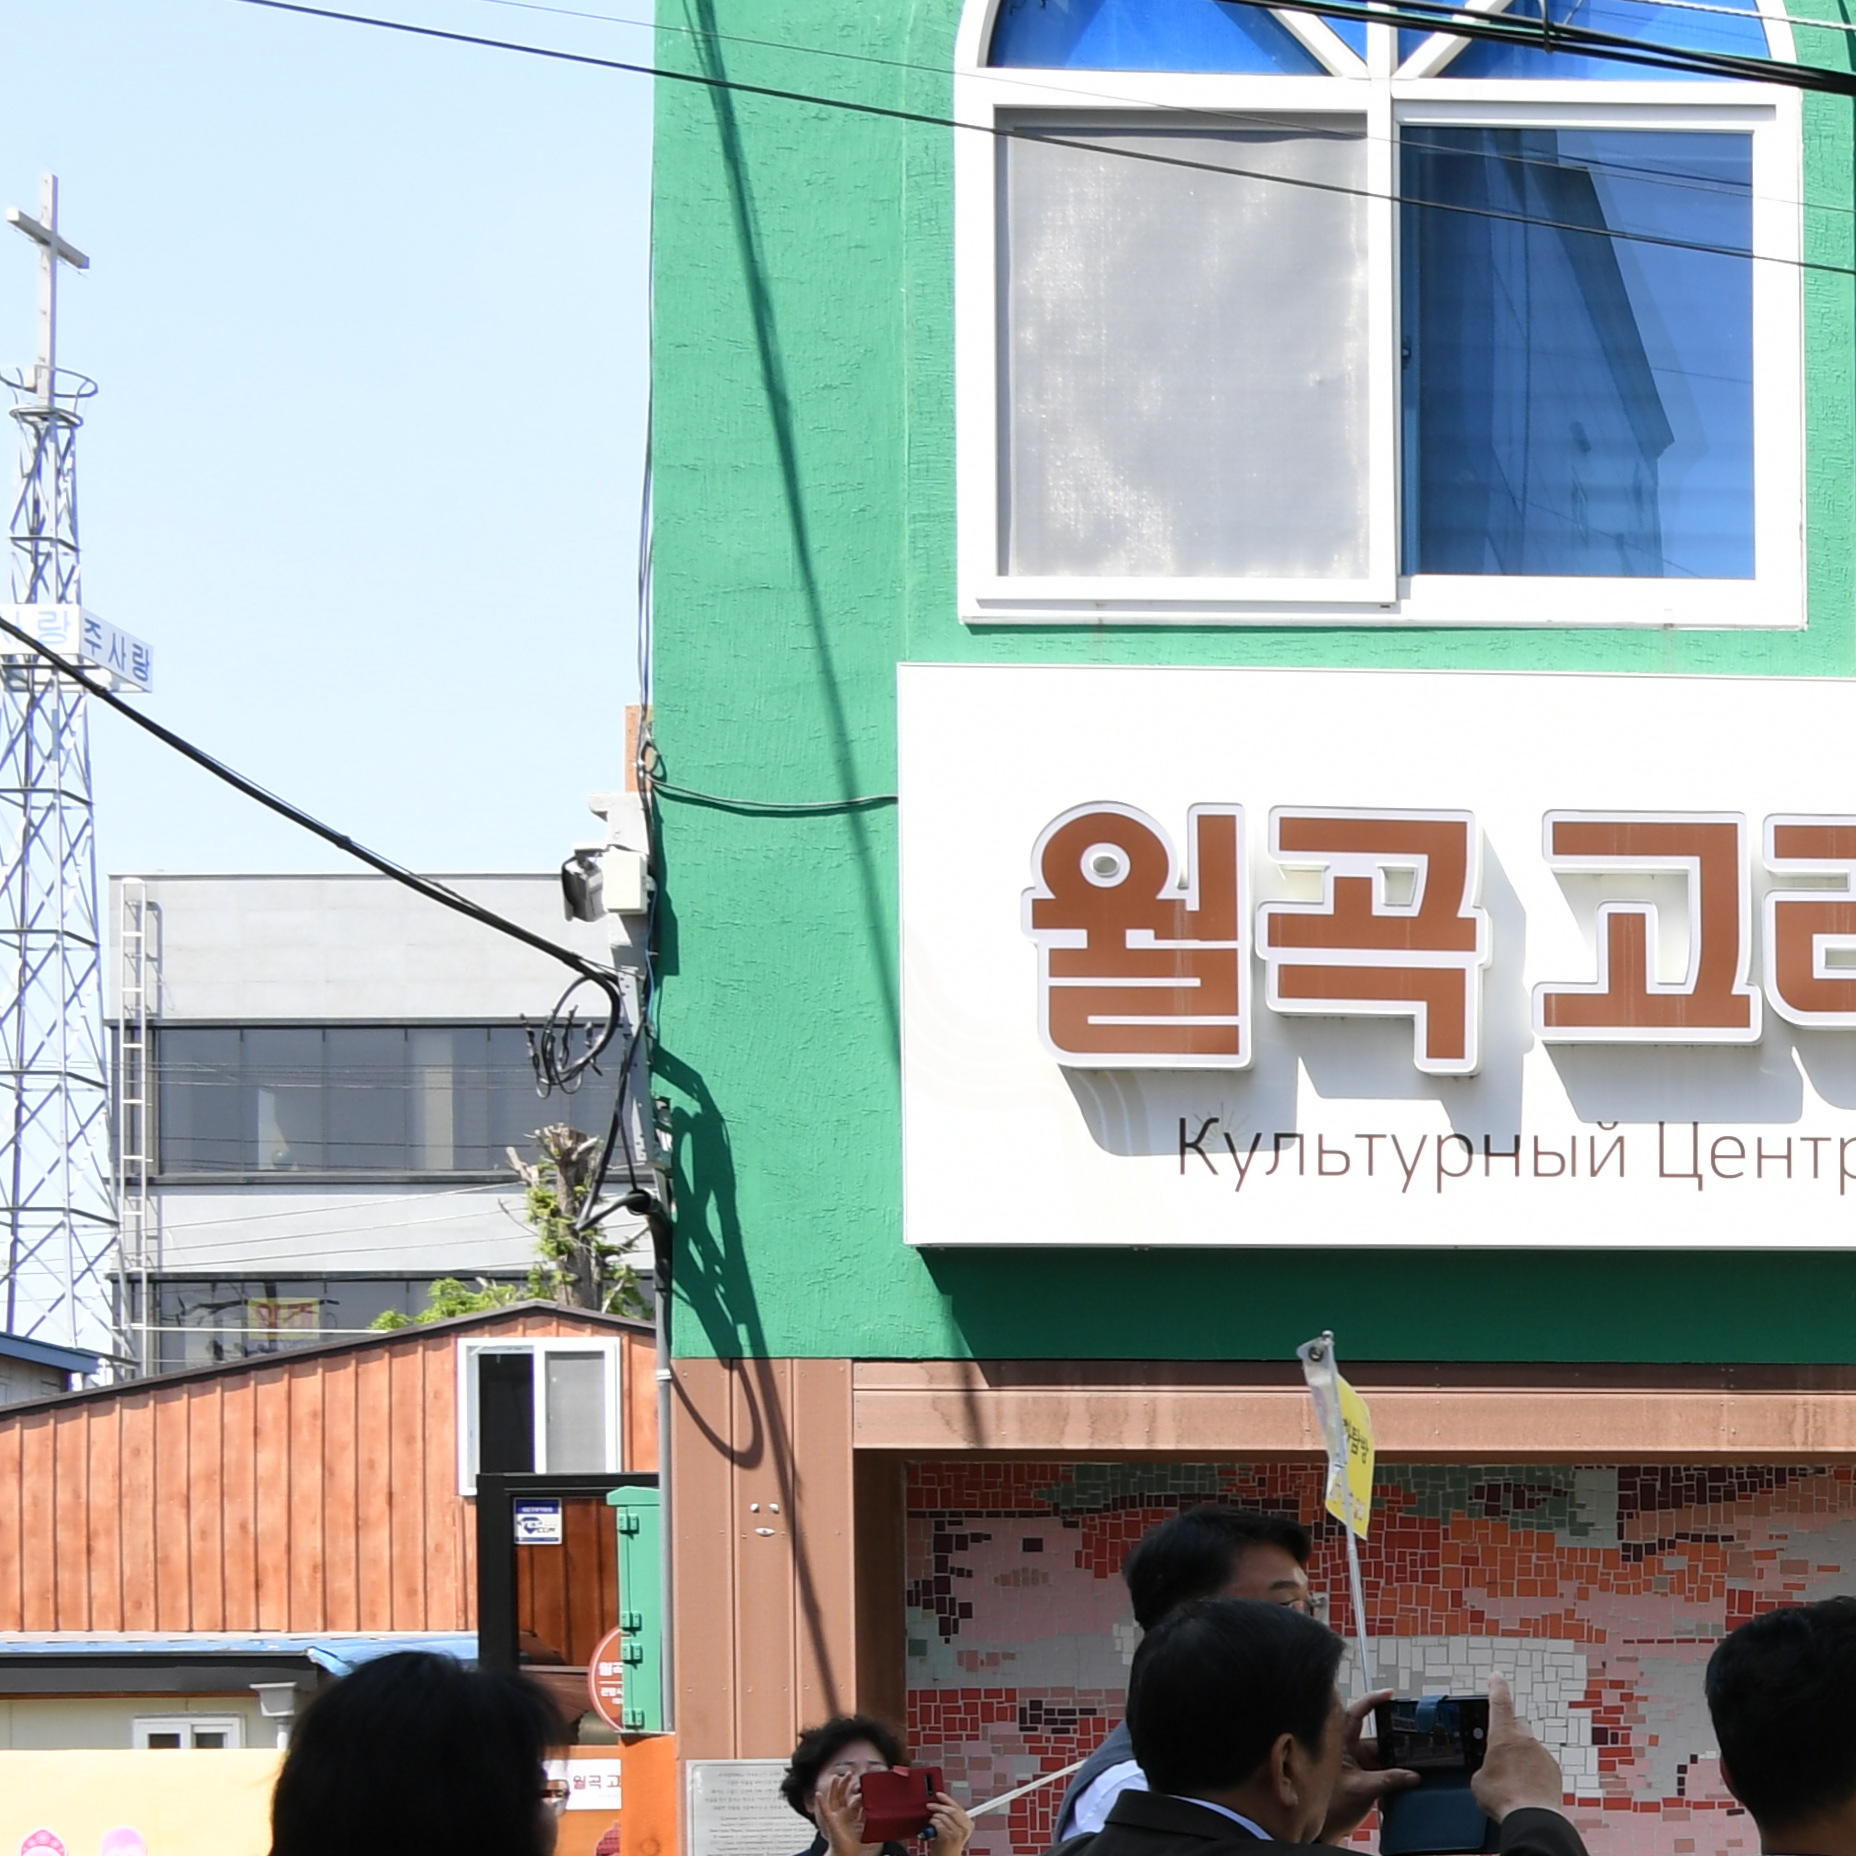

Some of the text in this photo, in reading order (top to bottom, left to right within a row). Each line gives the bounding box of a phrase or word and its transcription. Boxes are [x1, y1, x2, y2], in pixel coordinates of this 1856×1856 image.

[83, 616, 151, 683] 주사랑
[1026, 806, 1484, 1066] 월곡
[1176, 1116, 1623, 1192] Культурный
